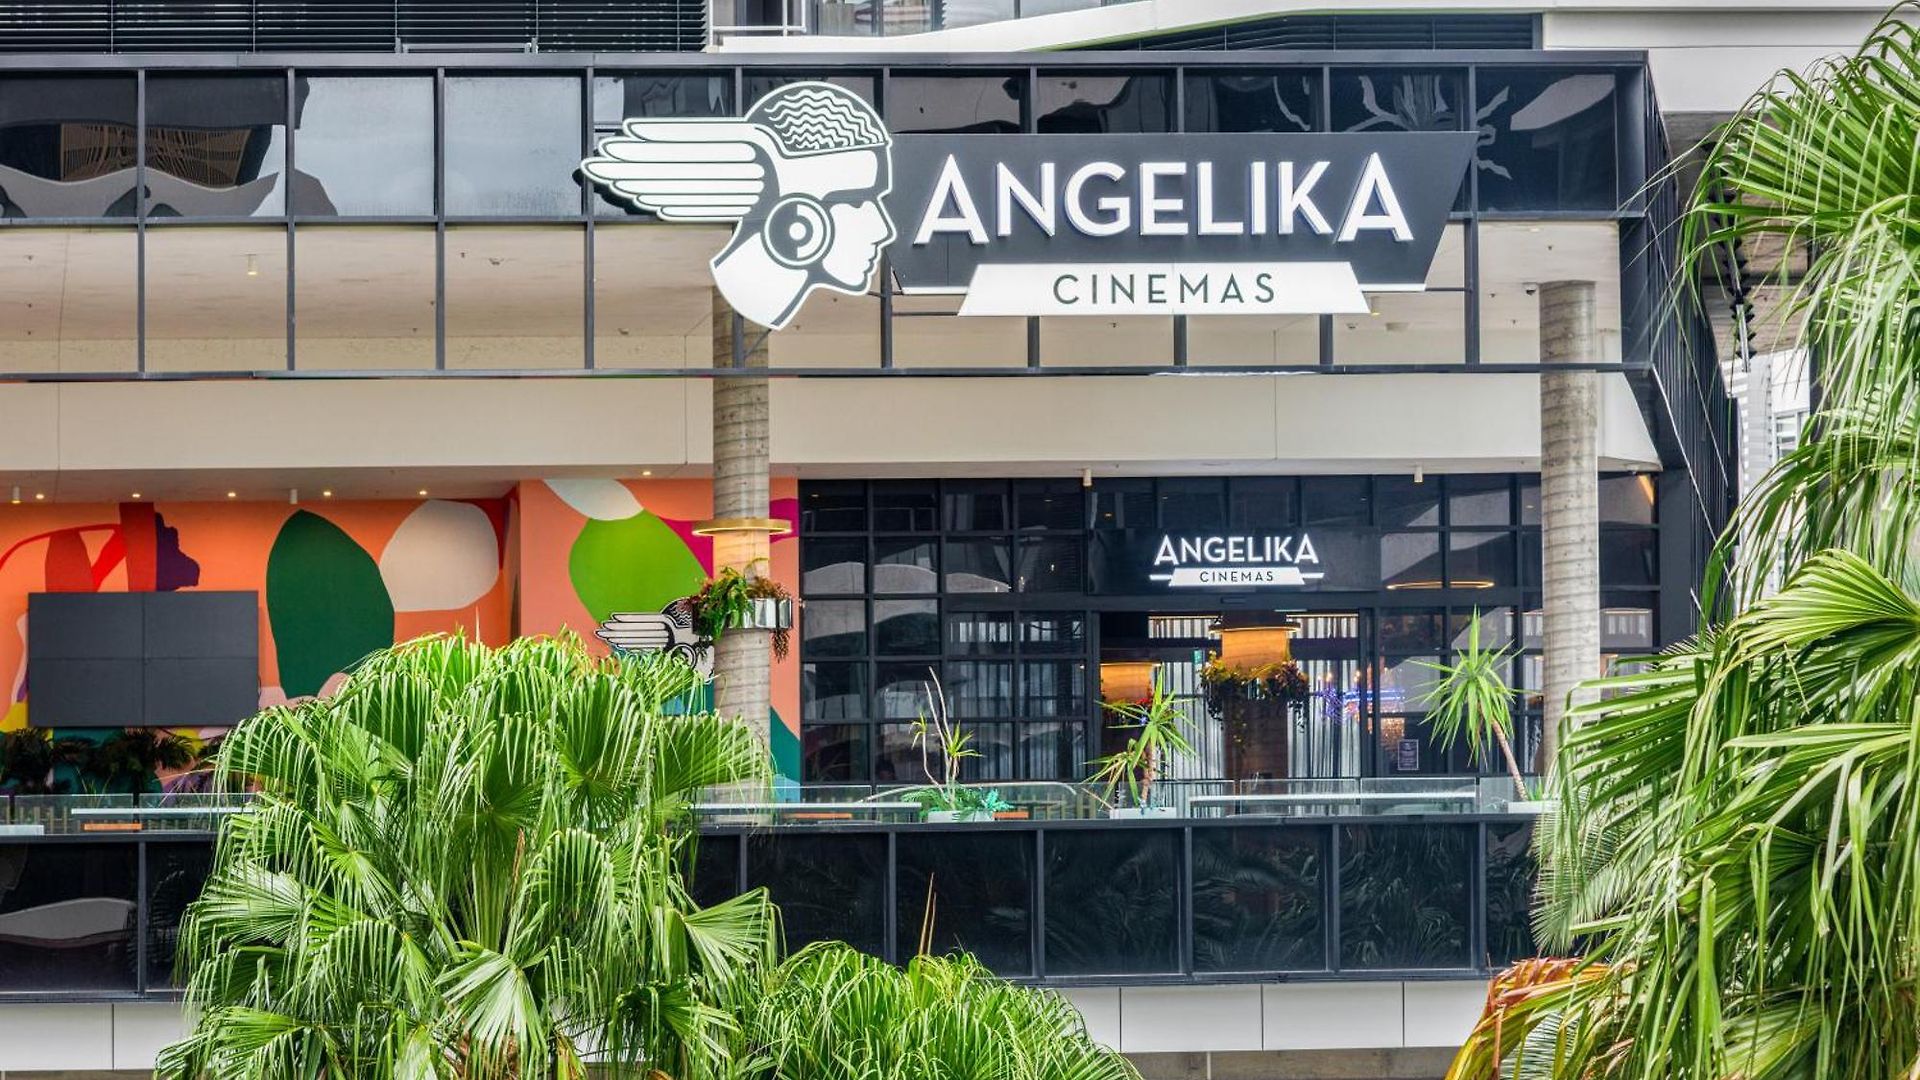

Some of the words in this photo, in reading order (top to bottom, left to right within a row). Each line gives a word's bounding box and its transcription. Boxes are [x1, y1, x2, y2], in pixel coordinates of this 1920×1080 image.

[913, 152, 1413, 245] ANGELIKA
[1053, 273, 1275, 304] CINEMAS
[1154, 534, 1319, 565] ANGELIKA
[1200, 572, 1274, 583] CINEMAS
